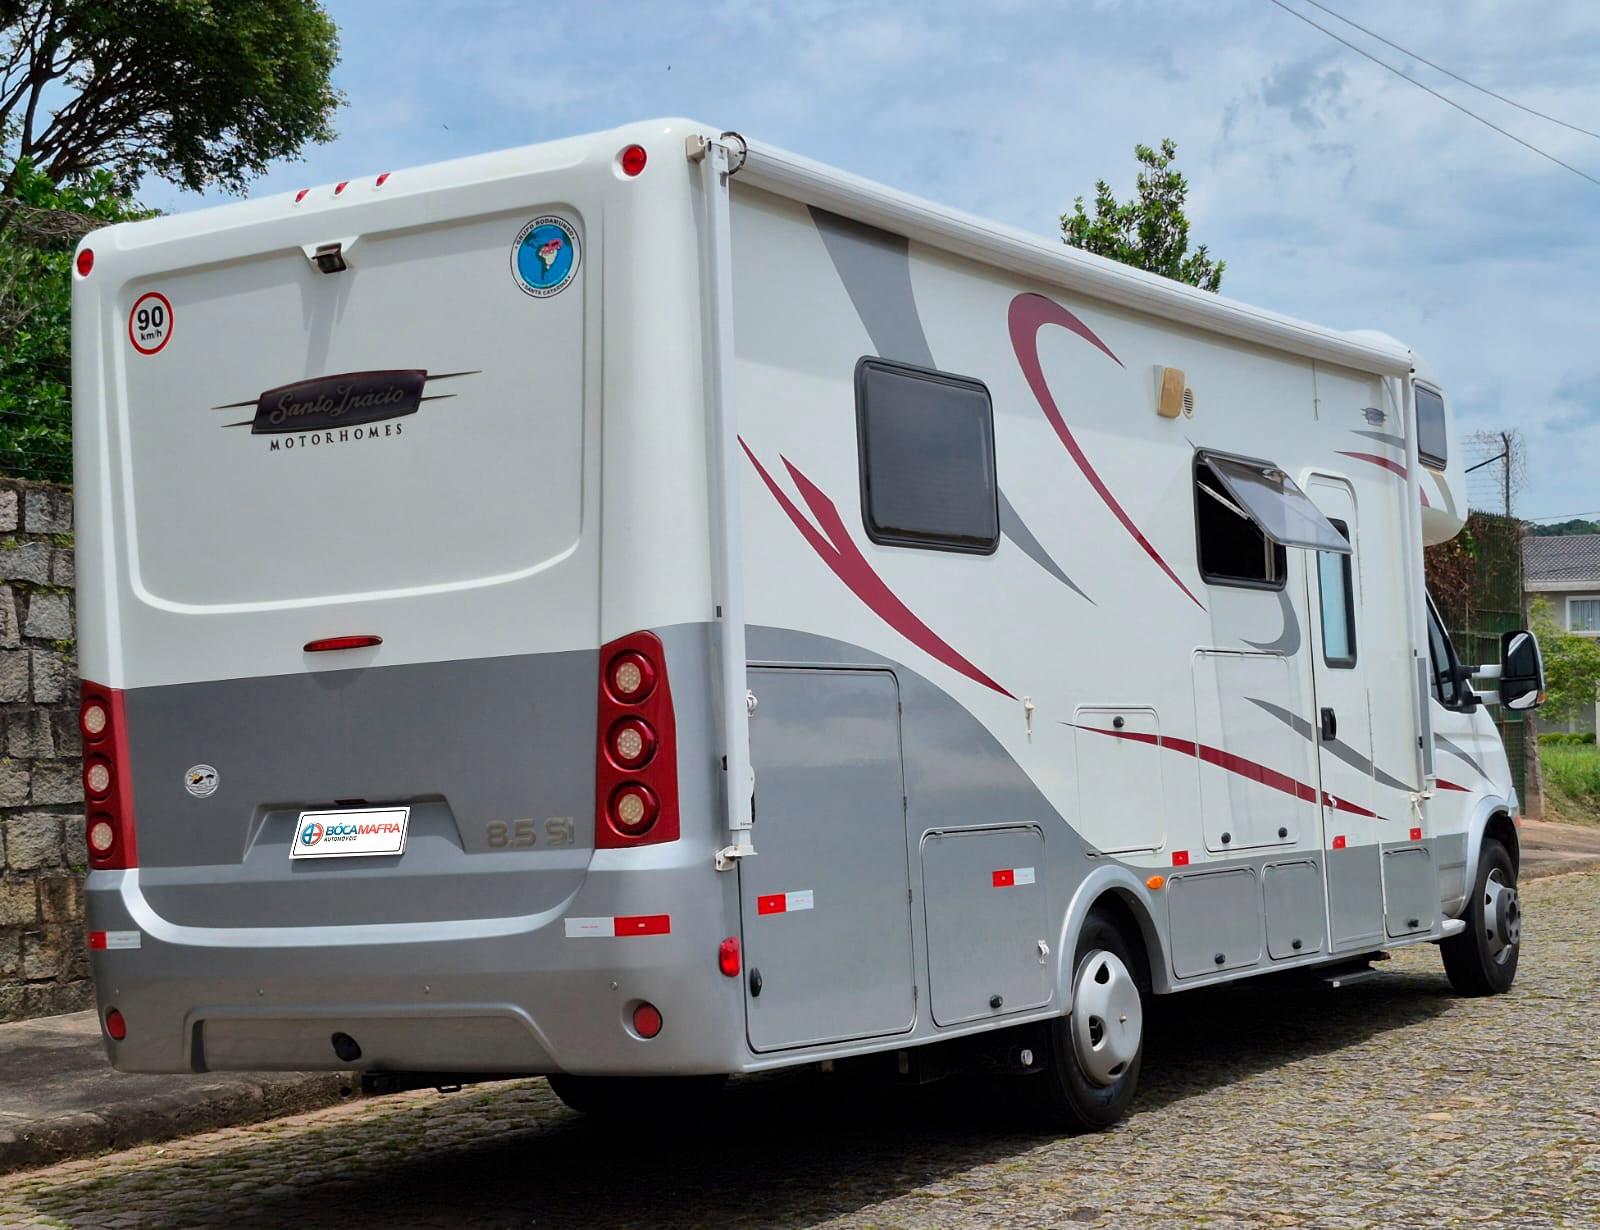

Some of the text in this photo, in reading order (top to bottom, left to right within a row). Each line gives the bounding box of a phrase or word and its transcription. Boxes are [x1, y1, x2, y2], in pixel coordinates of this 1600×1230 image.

[516, 223, 535, 246] GRUPO
[524, 278, 570, 296] SANTA CATARINA
[137, 305, 164, 331] 90
[140, 329, 163, 341] km/h
[270, 391, 334, 425] Santo
[269, 422, 403, 451] MOTORHOMES
[485, 818, 537, 849] 8.5
